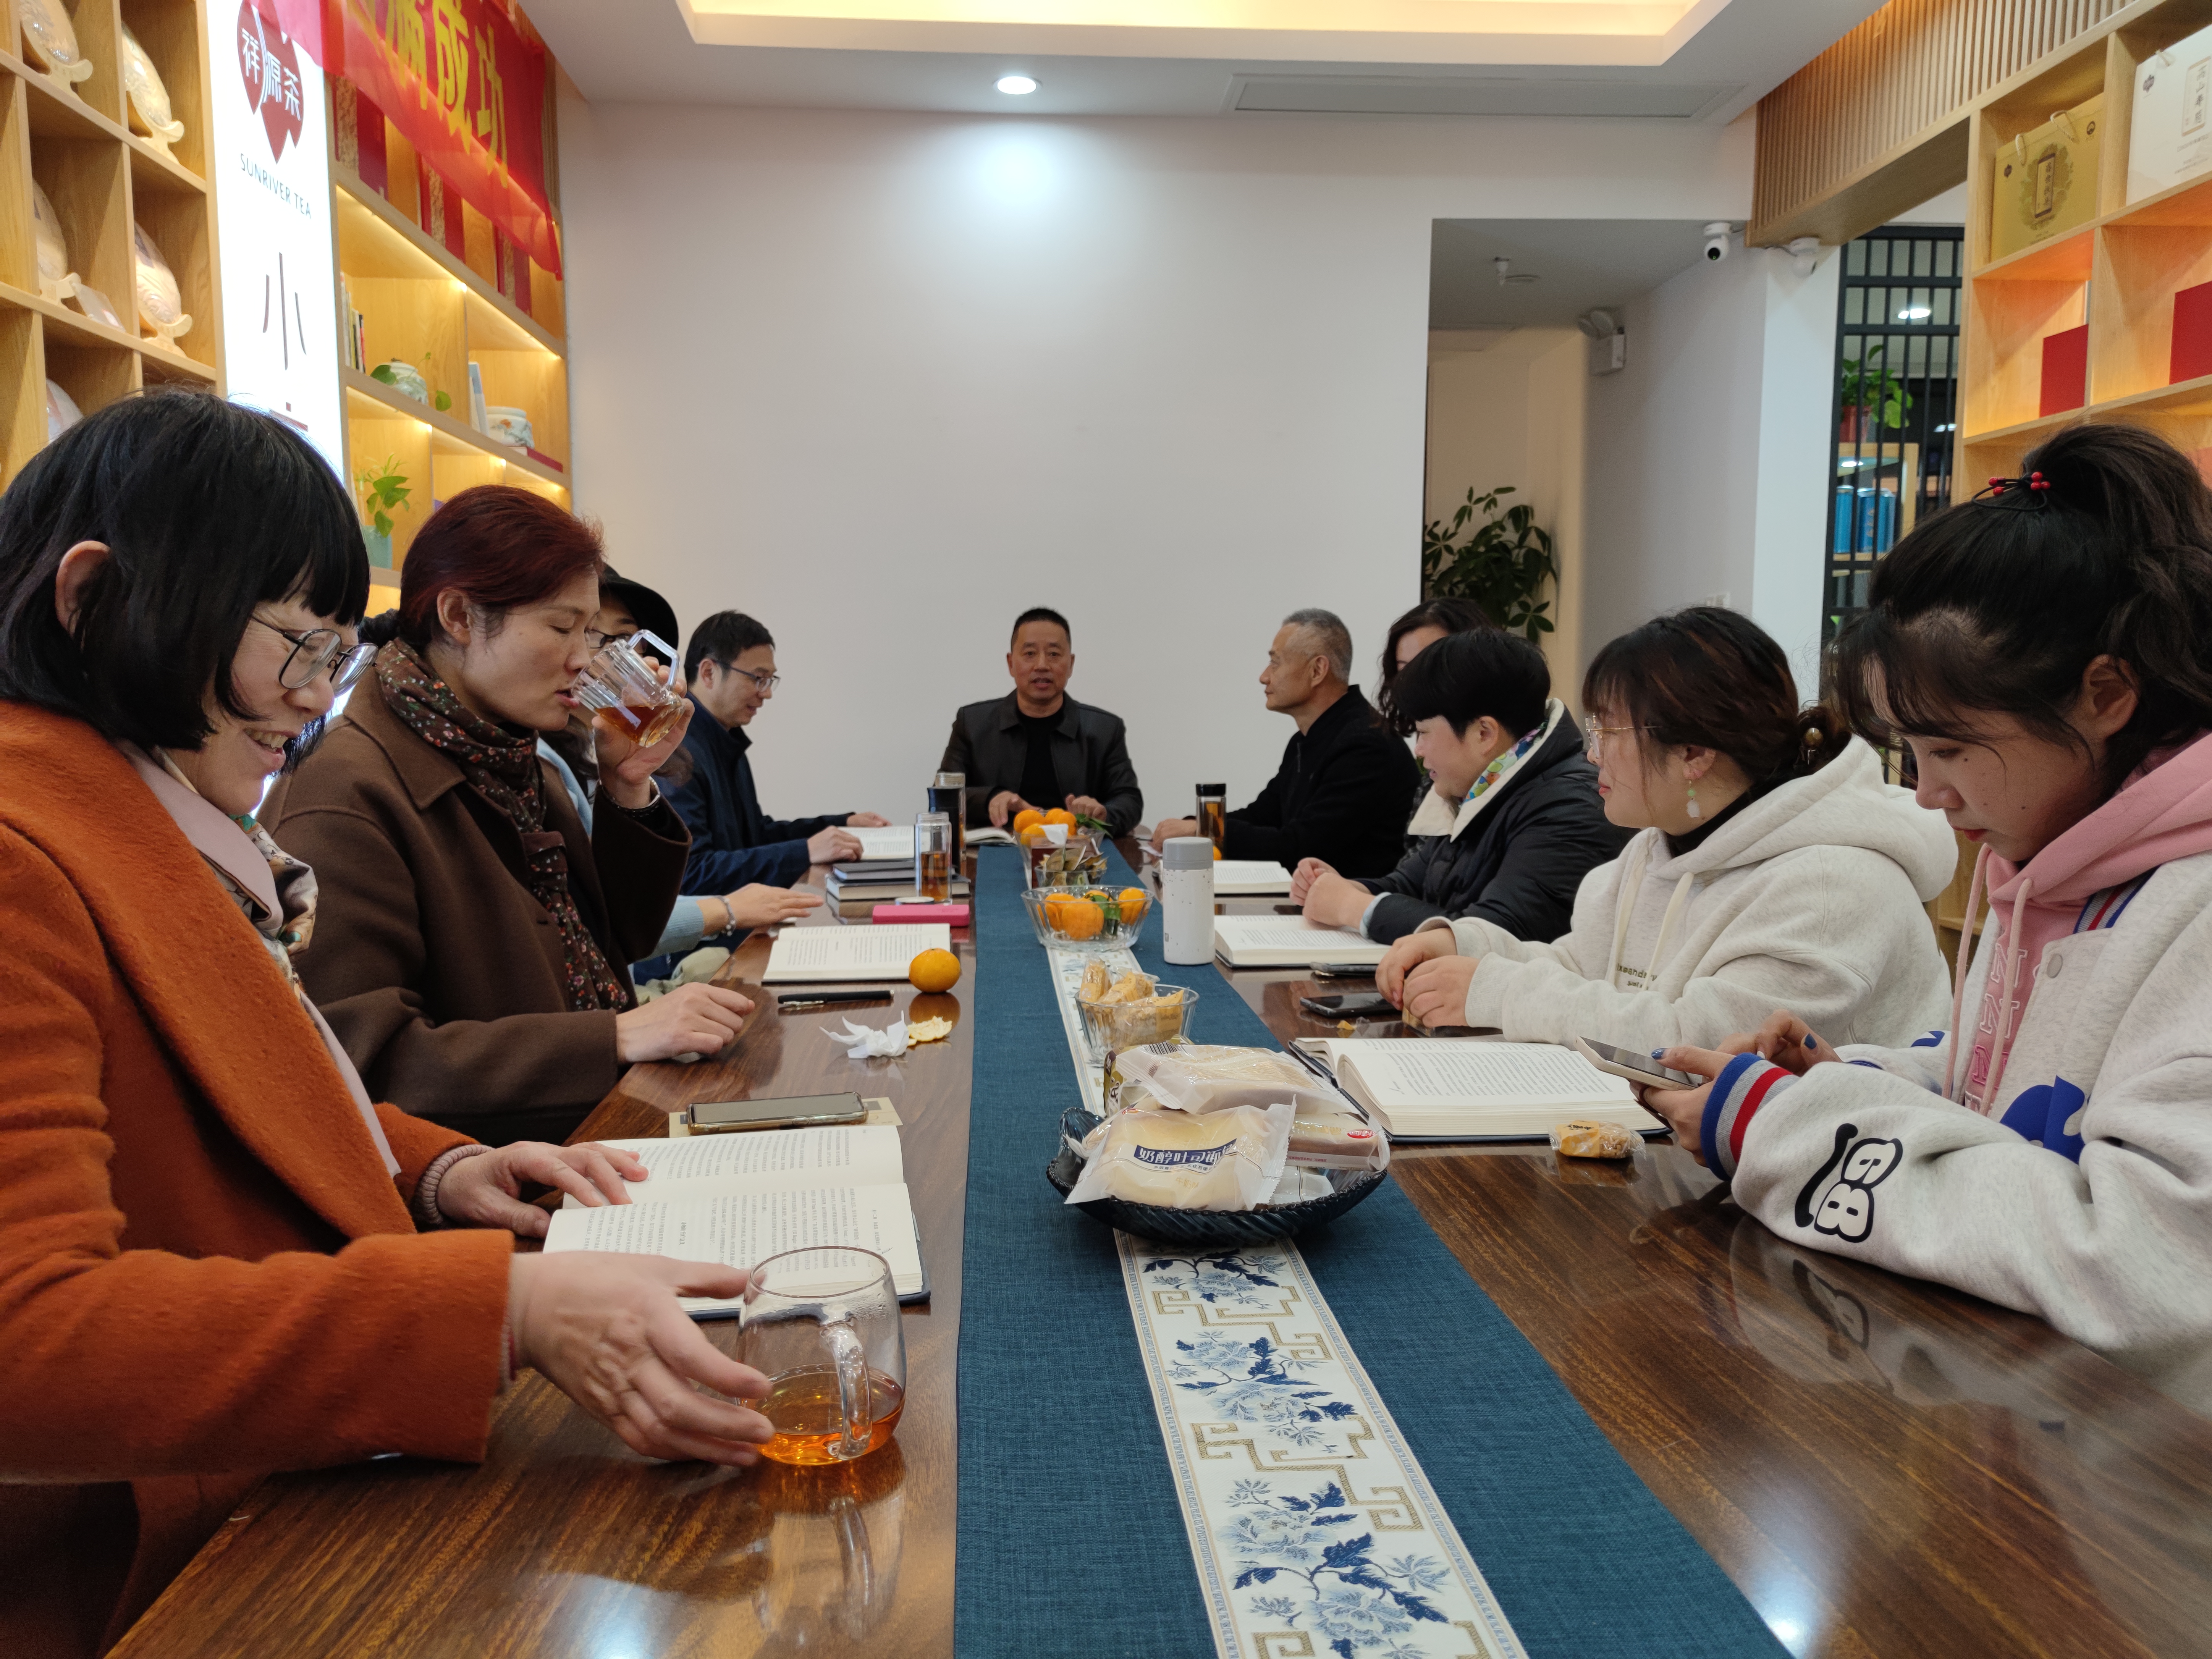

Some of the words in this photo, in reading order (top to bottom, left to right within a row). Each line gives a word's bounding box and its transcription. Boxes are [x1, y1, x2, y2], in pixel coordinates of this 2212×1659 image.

[241, 27, 301, 121] 祥源茶
[240, 153, 291, 204] SUNRIVER
[294, 192, 311, 219] TEA
